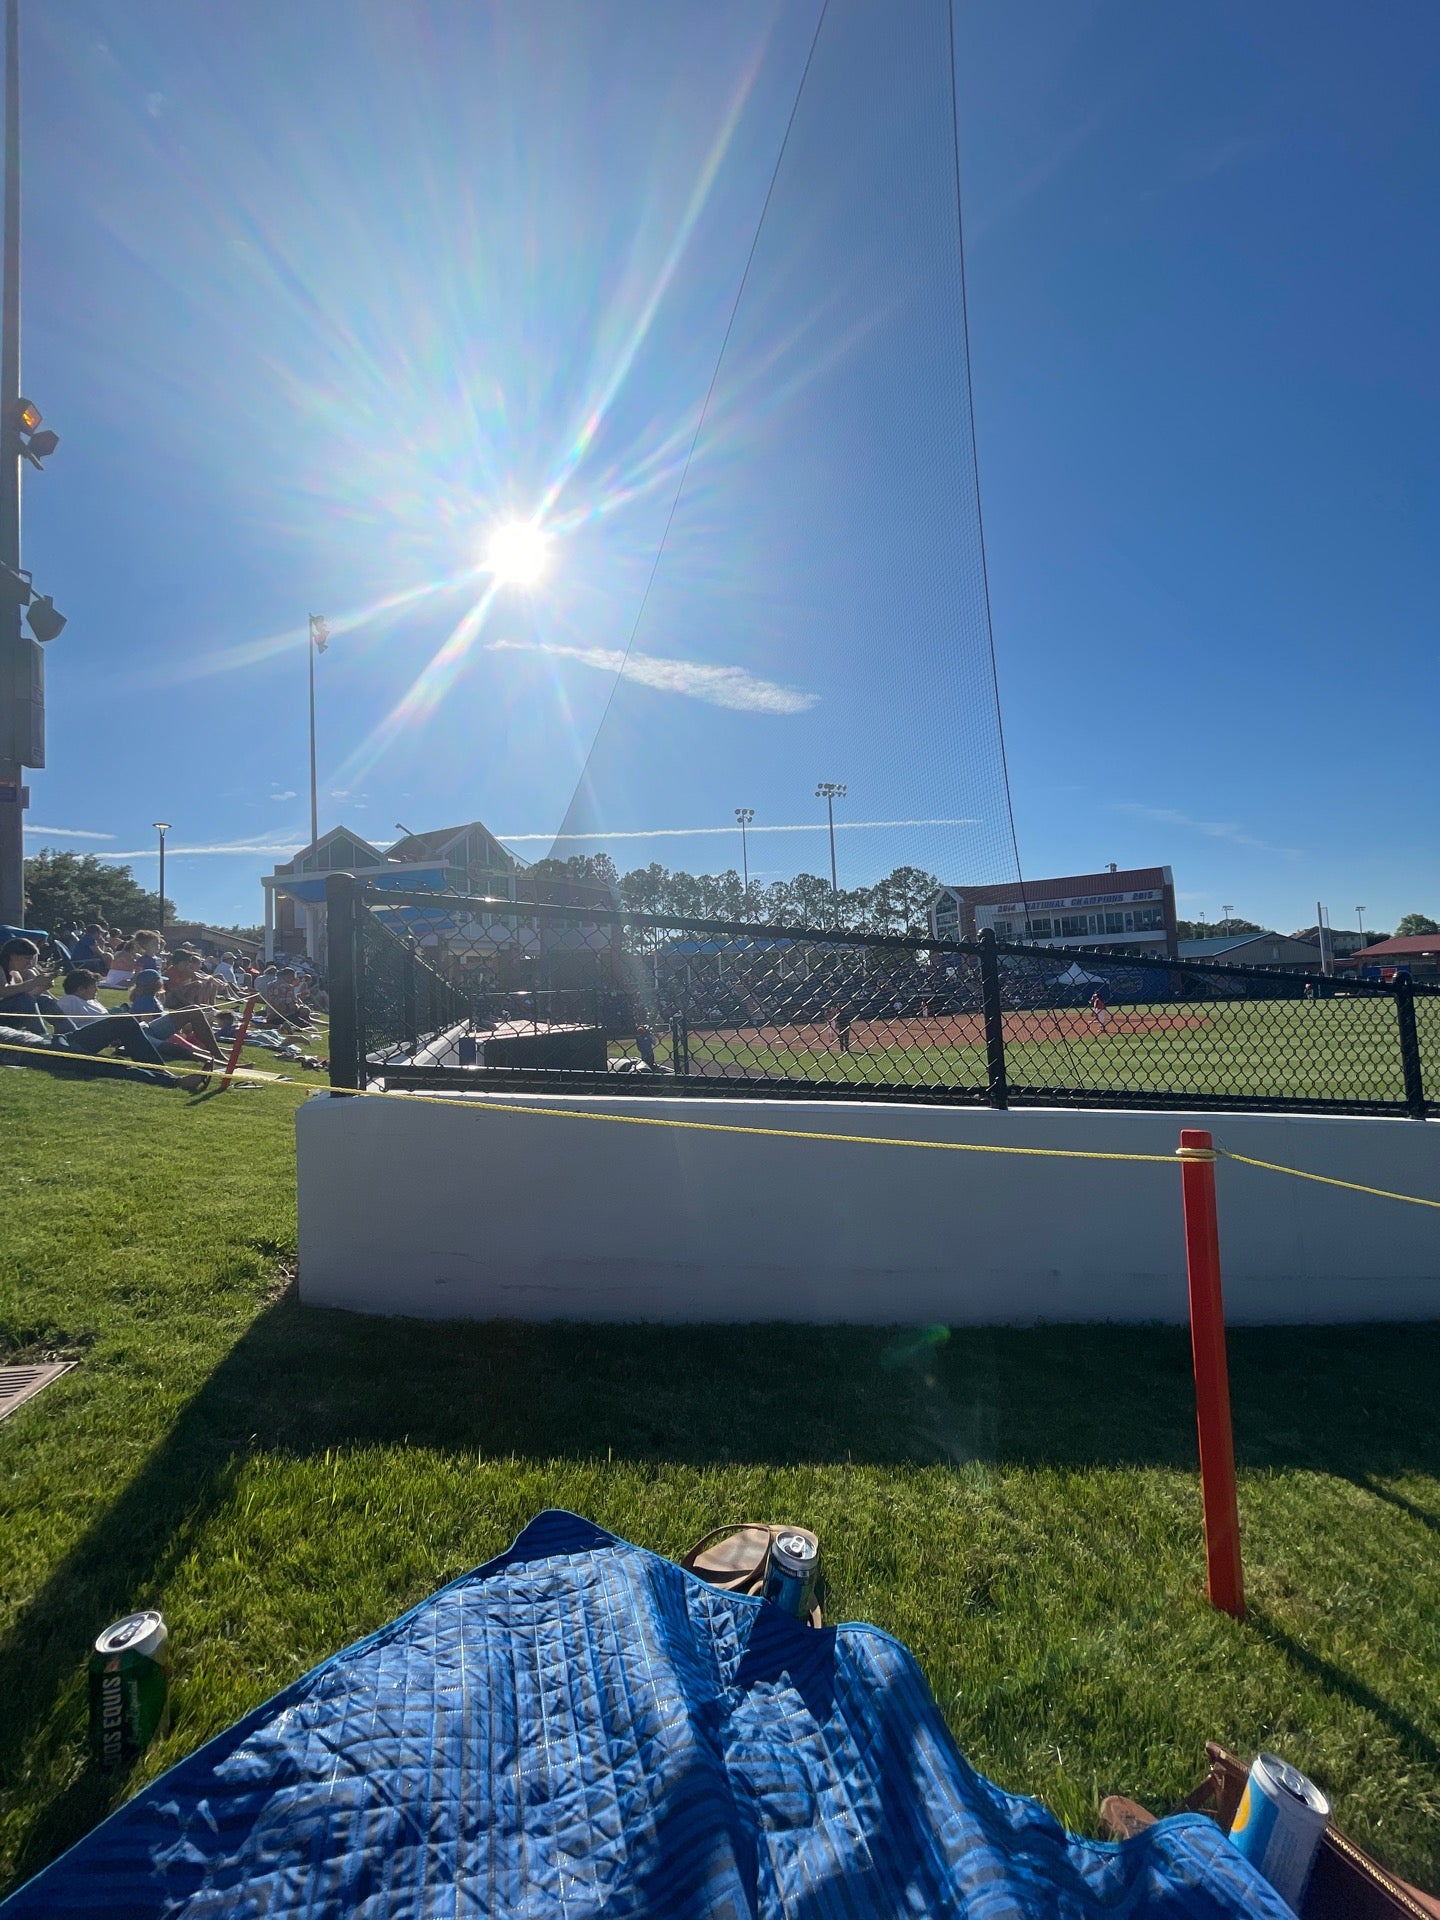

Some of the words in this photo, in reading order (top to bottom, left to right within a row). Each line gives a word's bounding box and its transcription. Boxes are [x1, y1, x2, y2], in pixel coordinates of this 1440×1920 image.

[1025, 900, 1066, 911] NATIONAL
[1070, 894, 1124, 906] CHAMPIONS
[1132, 891, 1154, 901] 2015
[102, 1675, 123, 1729] EQUIS
[103, 1731, 122, 1766] DOS
